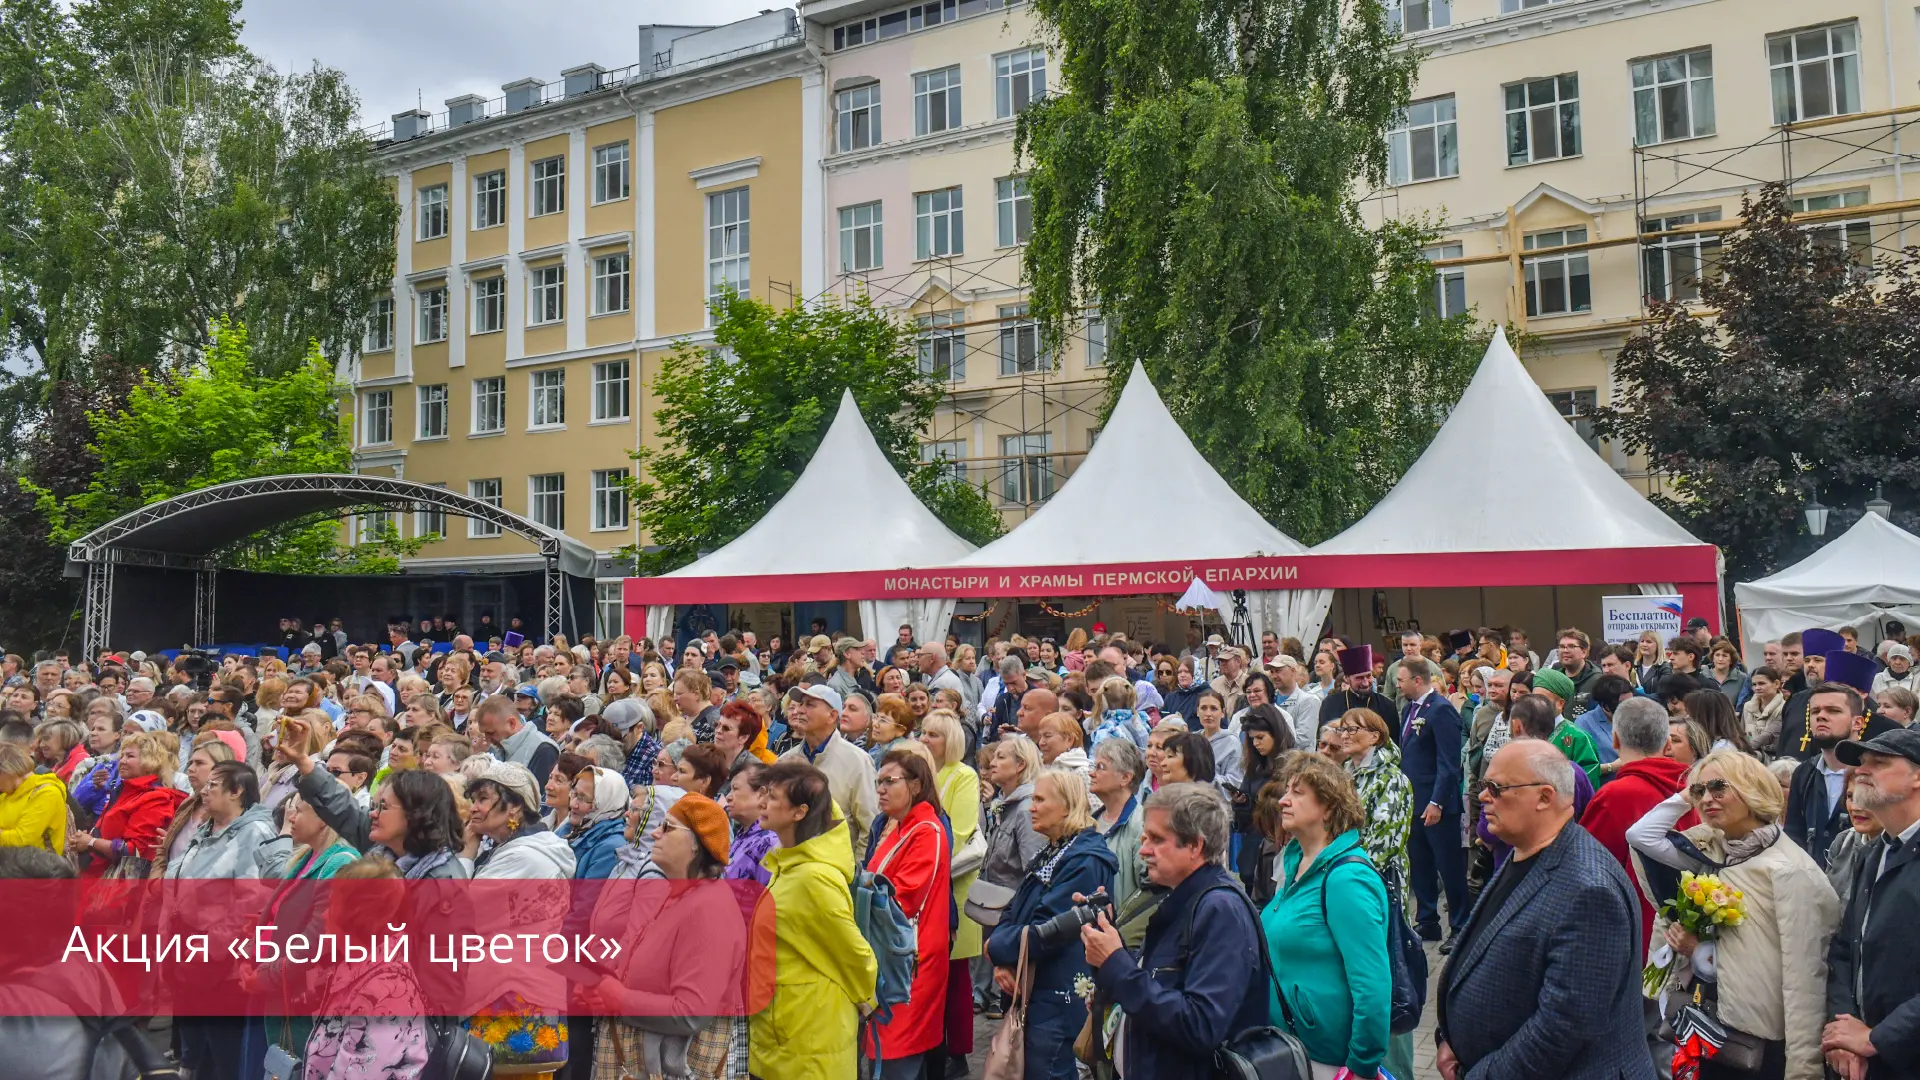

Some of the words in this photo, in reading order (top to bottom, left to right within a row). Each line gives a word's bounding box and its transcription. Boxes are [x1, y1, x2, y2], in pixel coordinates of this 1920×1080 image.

[884, 576, 989, 591] МОНАСТЫРИ
[1000, 575, 1010, 588] И
[1020, 574, 1083, 588] ХРАМЫ
[1093, 566, 1194, 586] ПЕРМСКОЙ
[1206, 566, 1298, 582] ЕПАРХИИ
[1609, 609, 1676, 621] Бесплатно
[1608, 622, 1639, 633] отправь
[1641, 622, 1679, 633] открытку
